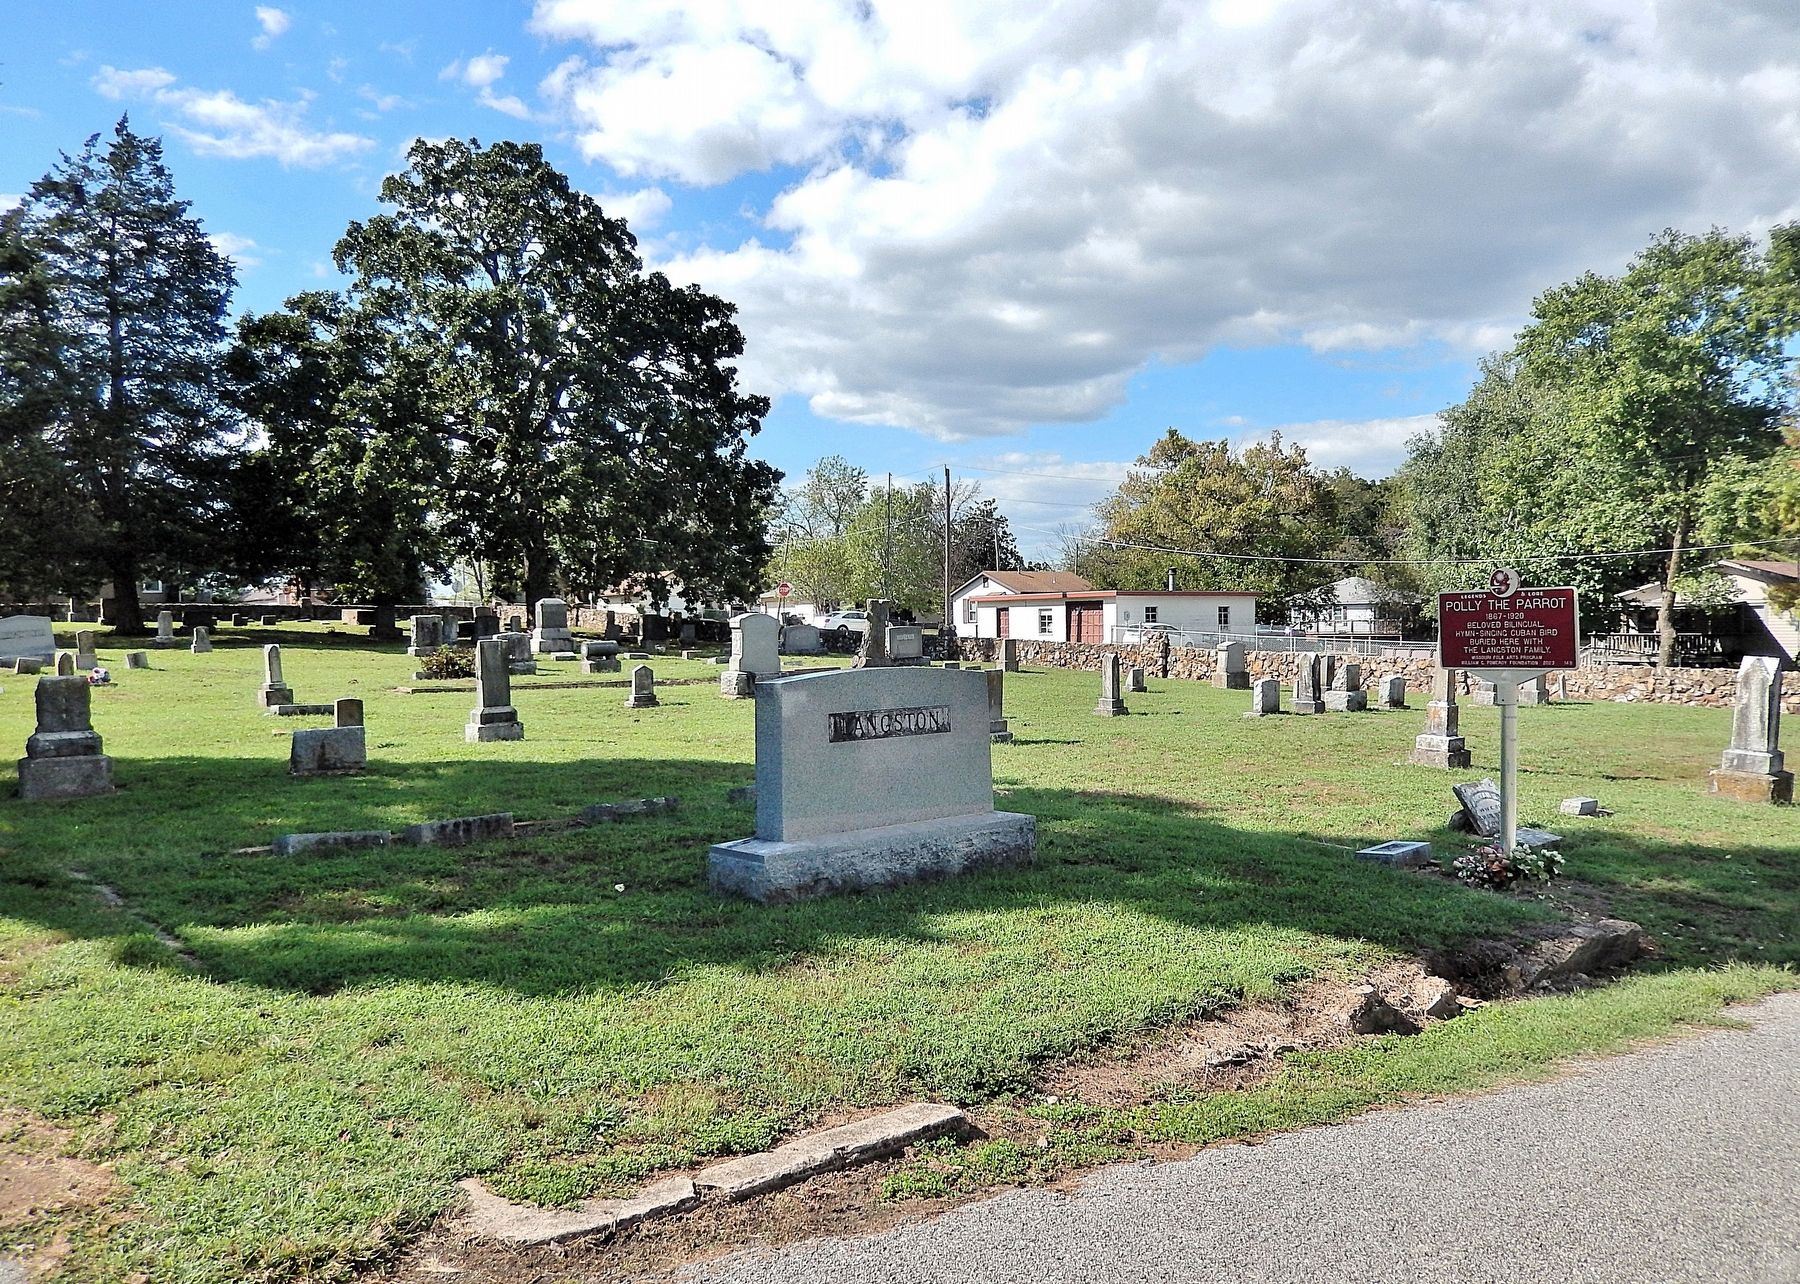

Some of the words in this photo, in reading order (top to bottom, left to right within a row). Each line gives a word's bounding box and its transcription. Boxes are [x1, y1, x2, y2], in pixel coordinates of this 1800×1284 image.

[1445, 600, 1482, 612] POLLY
[1487, 599, 1511, 610] THE
[1516, 597, 1567, 610] PARROT
[1485, 612, 1525, 620] 1867-1920
[1467, 621, 1501, 629] BELOVED
[1455, 629, 1508, 637] HYMN-SINGING
[1510, 629, 1537, 637] CUBAN
[1539, 628, 1558, 637] BIRD
[1469, 638, 1497, 646] BURIED
[1523, 637, 1543, 645] WITH
[1463, 646, 1479, 654] THE
[1480, 646, 1521, 654] LANGSTON
[834, 710, 940, 737] LANGSTON
